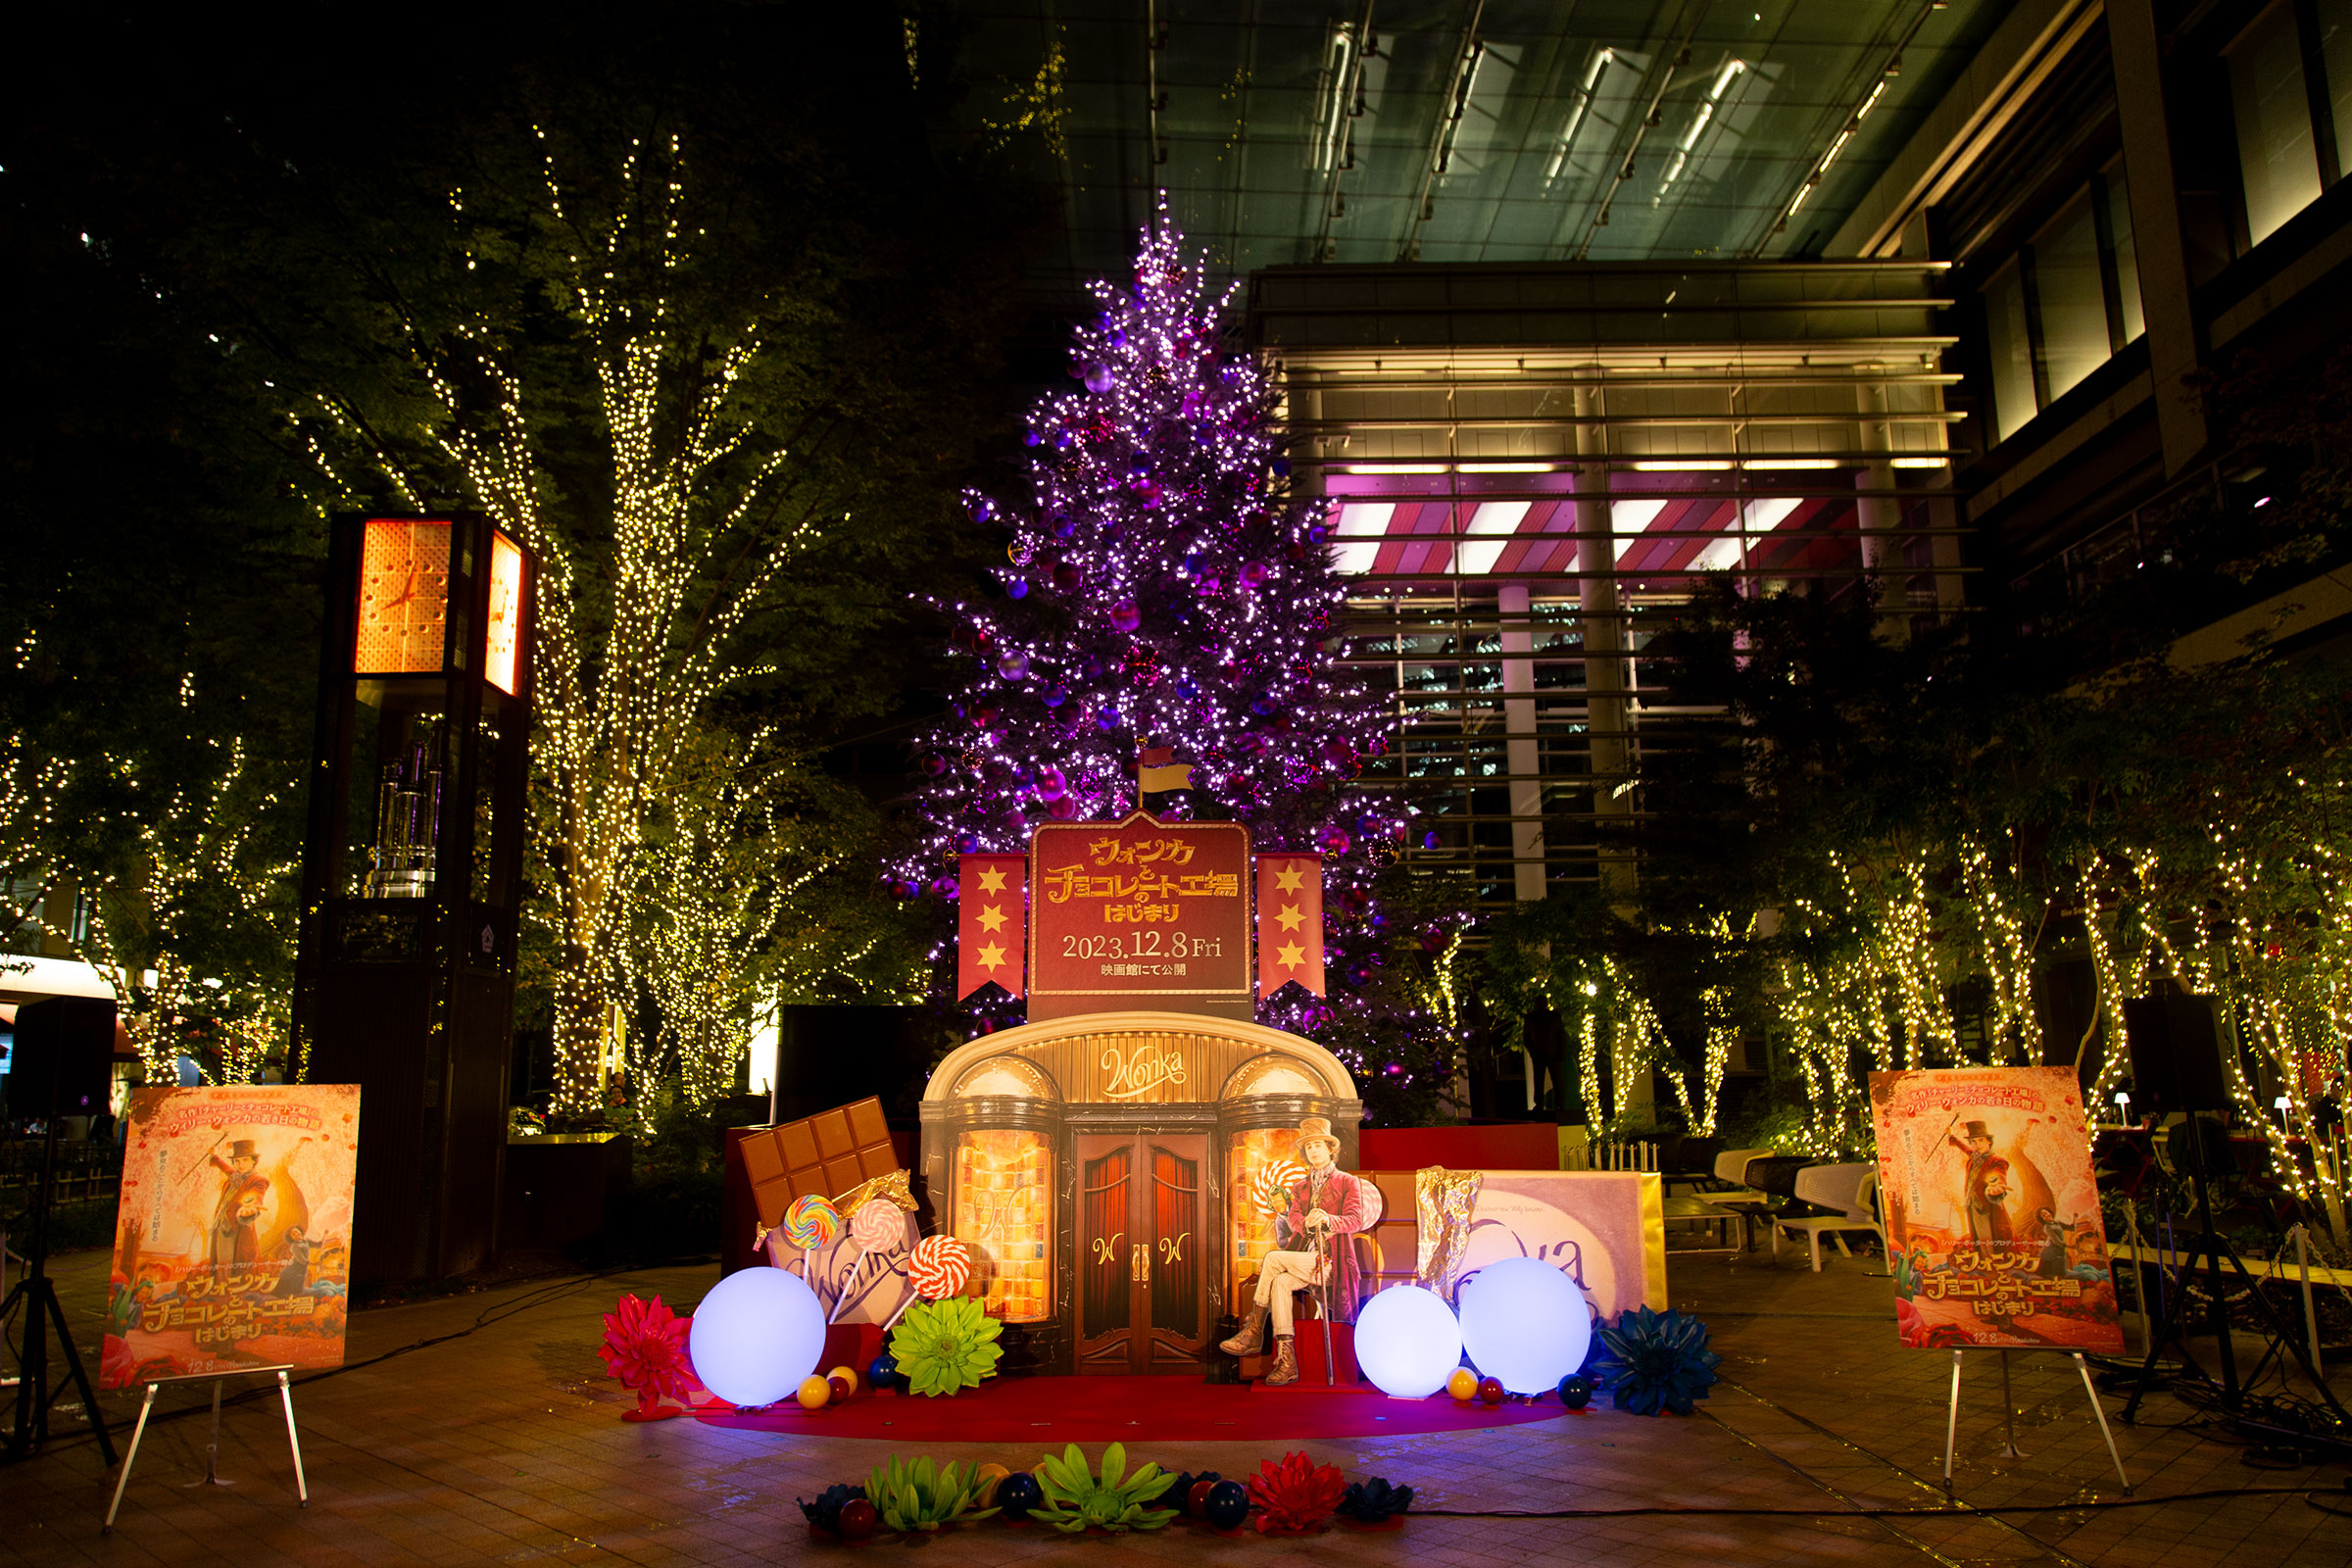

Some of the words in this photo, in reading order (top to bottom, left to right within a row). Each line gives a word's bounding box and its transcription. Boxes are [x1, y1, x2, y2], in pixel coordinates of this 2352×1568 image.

[1089, 837, 1197, 866] ウォンカ
[1045, 863, 1239, 904] チョコレート工場
[1140, 864, 1156, 881] と
[1134, 891, 1151, 903] の
[1104, 903, 1180, 923] はじまり
[1062, 930, 1189, 959] 2023.12.8
[1192, 937, 1222, 957] Fri
[1101, 963, 1187, 976] 映画館にて公開
[1101, 1045, 1188, 1099] Wonka
[1092, 1232, 1125, 1265] W
[1159, 1232, 1192, 1265] W
[1955, 1250, 2041, 1273] ウォンカ
[186, 1273, 281, 1299] ウォンカ
[1923, 1270, 2082, 1300] チョコレート工場
[143, 1296, 315, 1333] チョコレート工場
[1974, 1301, 2035, 1316] はじまり
[195, 1323, 263, 1344] はじまり
